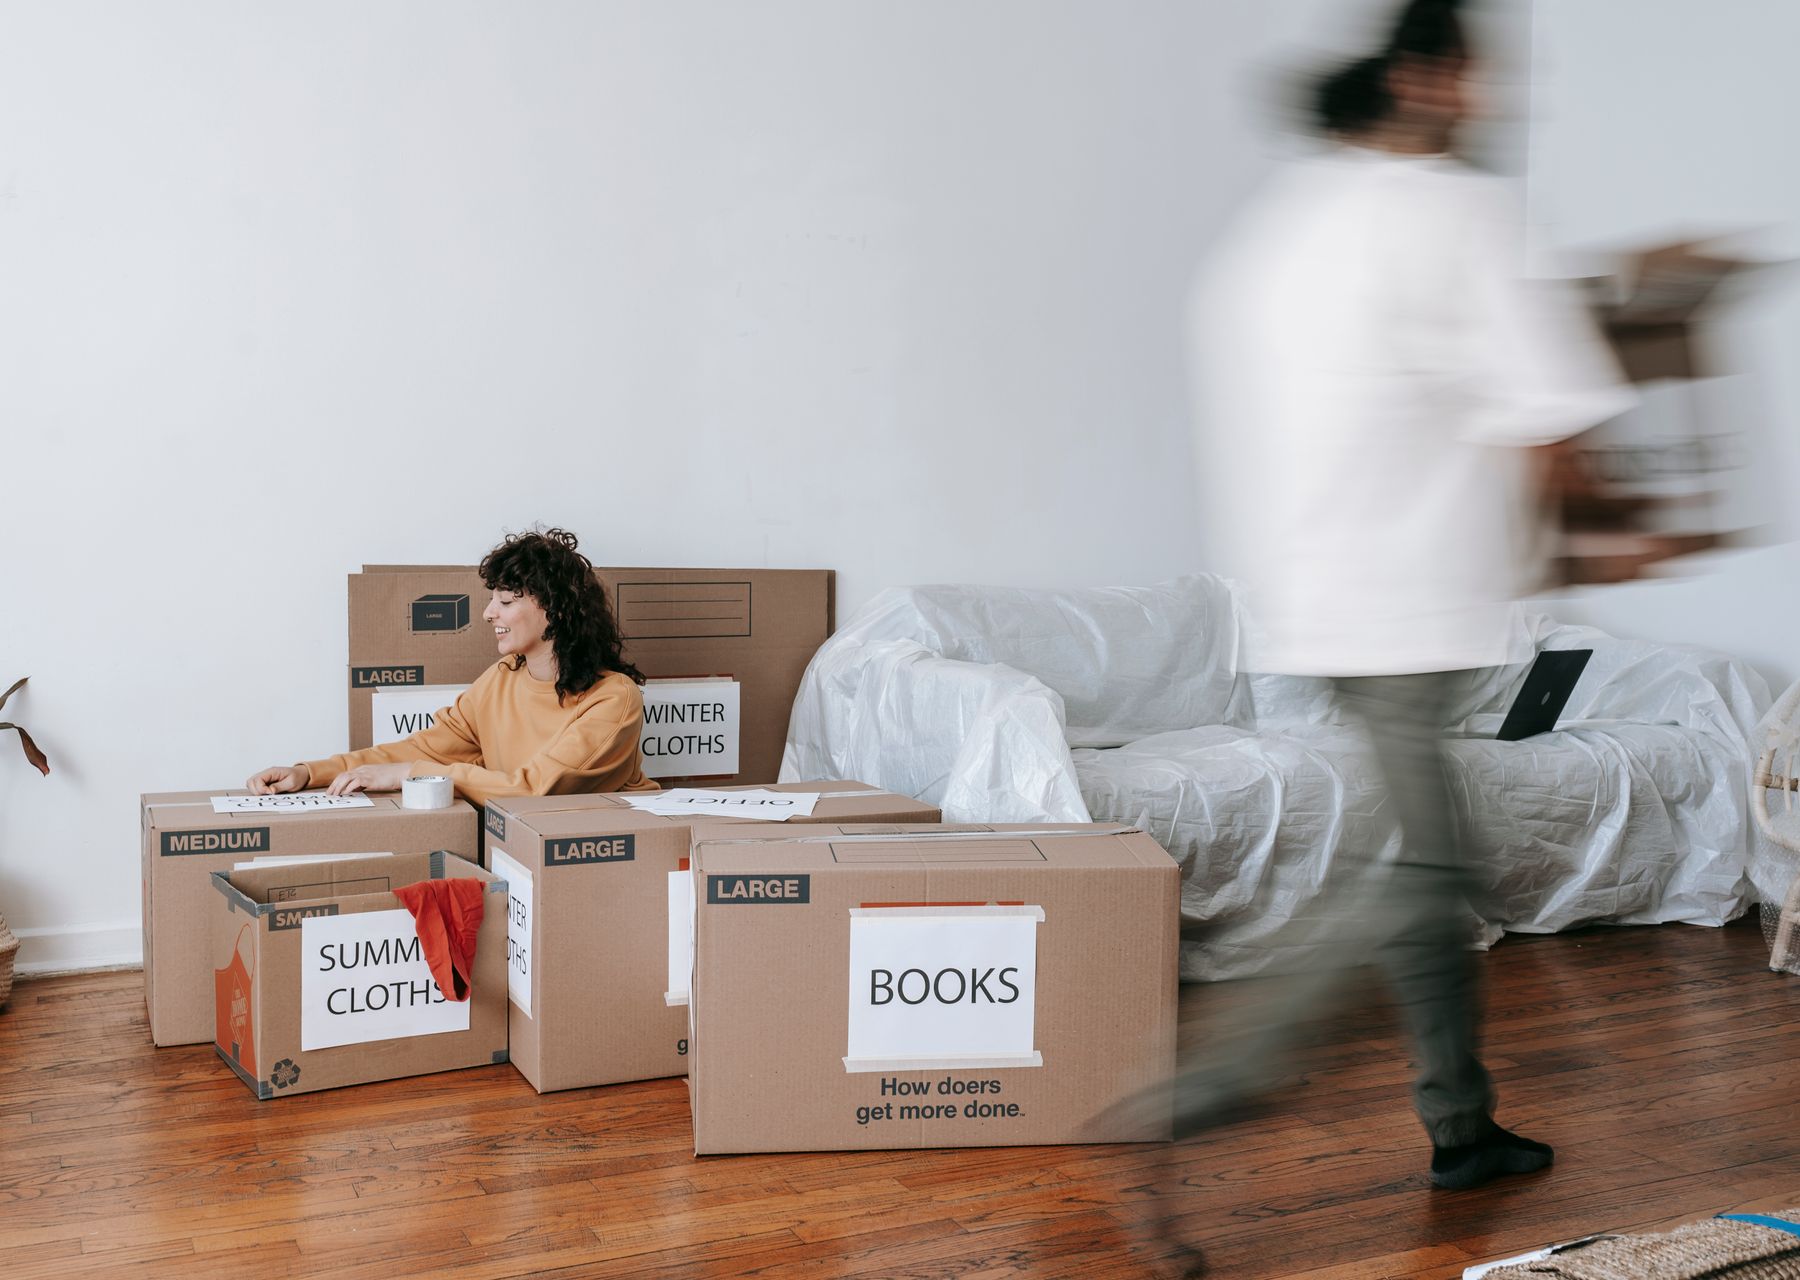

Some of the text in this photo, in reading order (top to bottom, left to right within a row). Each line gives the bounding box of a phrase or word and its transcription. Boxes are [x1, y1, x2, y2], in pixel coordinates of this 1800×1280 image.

[358, 669, 417, 684] LARGE
[392, 713, 434, 735] WIN
[643, 703, 725, 724] WINTER
[641, 734, 725, 757] CLOTHS
[677, 797, 794, 806] OFFICE
[486, 810, 504, 836] LARGE
[169, 831, 262, 852] MEDIUM
[553, 839, 625, 861] LARGE
[716, 878, 800, 899] LARGE
[507, 895, 527, 931] NTER
[319, 936, 427, 971] SUMM
[507, 936, 527, 975] OTHS
[327, 979, 446, 1015] CLOTHS
[870, 966, 1020, 1006] BOOKS
[881, 1076, 1002, 1096] How doers
[856, 1102, 893, 1125] get
[900, 1104, 957, 1120] more
